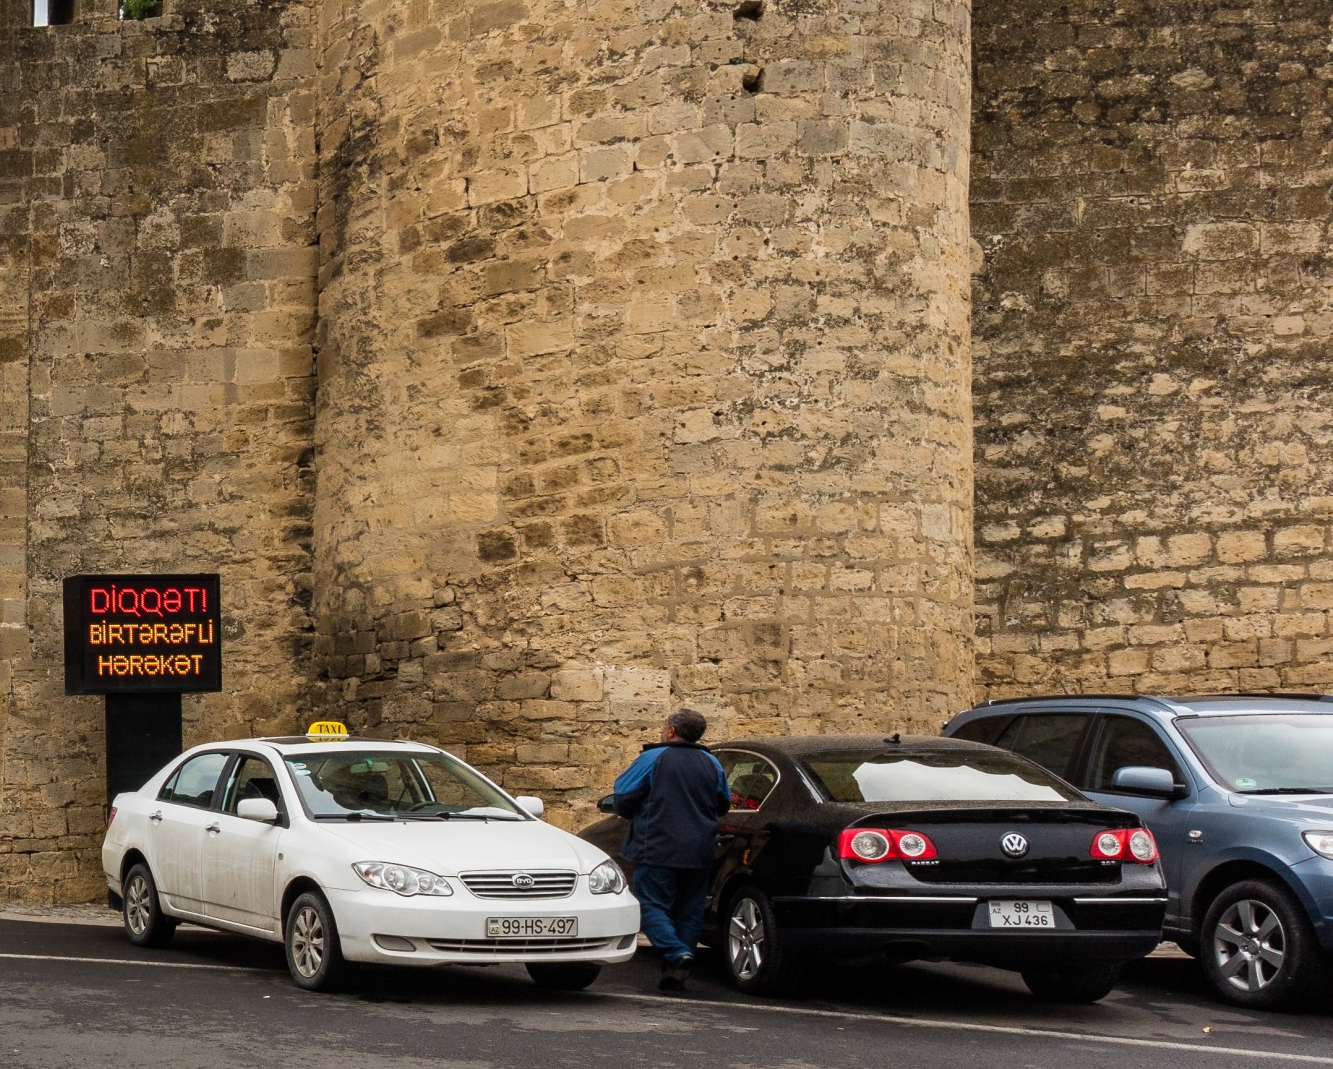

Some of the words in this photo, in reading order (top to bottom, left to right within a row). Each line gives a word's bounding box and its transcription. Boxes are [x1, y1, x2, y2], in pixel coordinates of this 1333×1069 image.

[90, 584, 207, 618] DİQQƏT!
[89, 619, 214, 645] BİRTƏRƏFLİ
[98, 655, 203, 676] HƏRƏKƏT
[317, 724, 341, 734] TAXI
[1014, 902, 1029, 913] 99
[502, 918, 575, 934] 99-HS-497
[1002, 915, 1022, 926] XJ
[1025, 915, 1048, 926] 436
